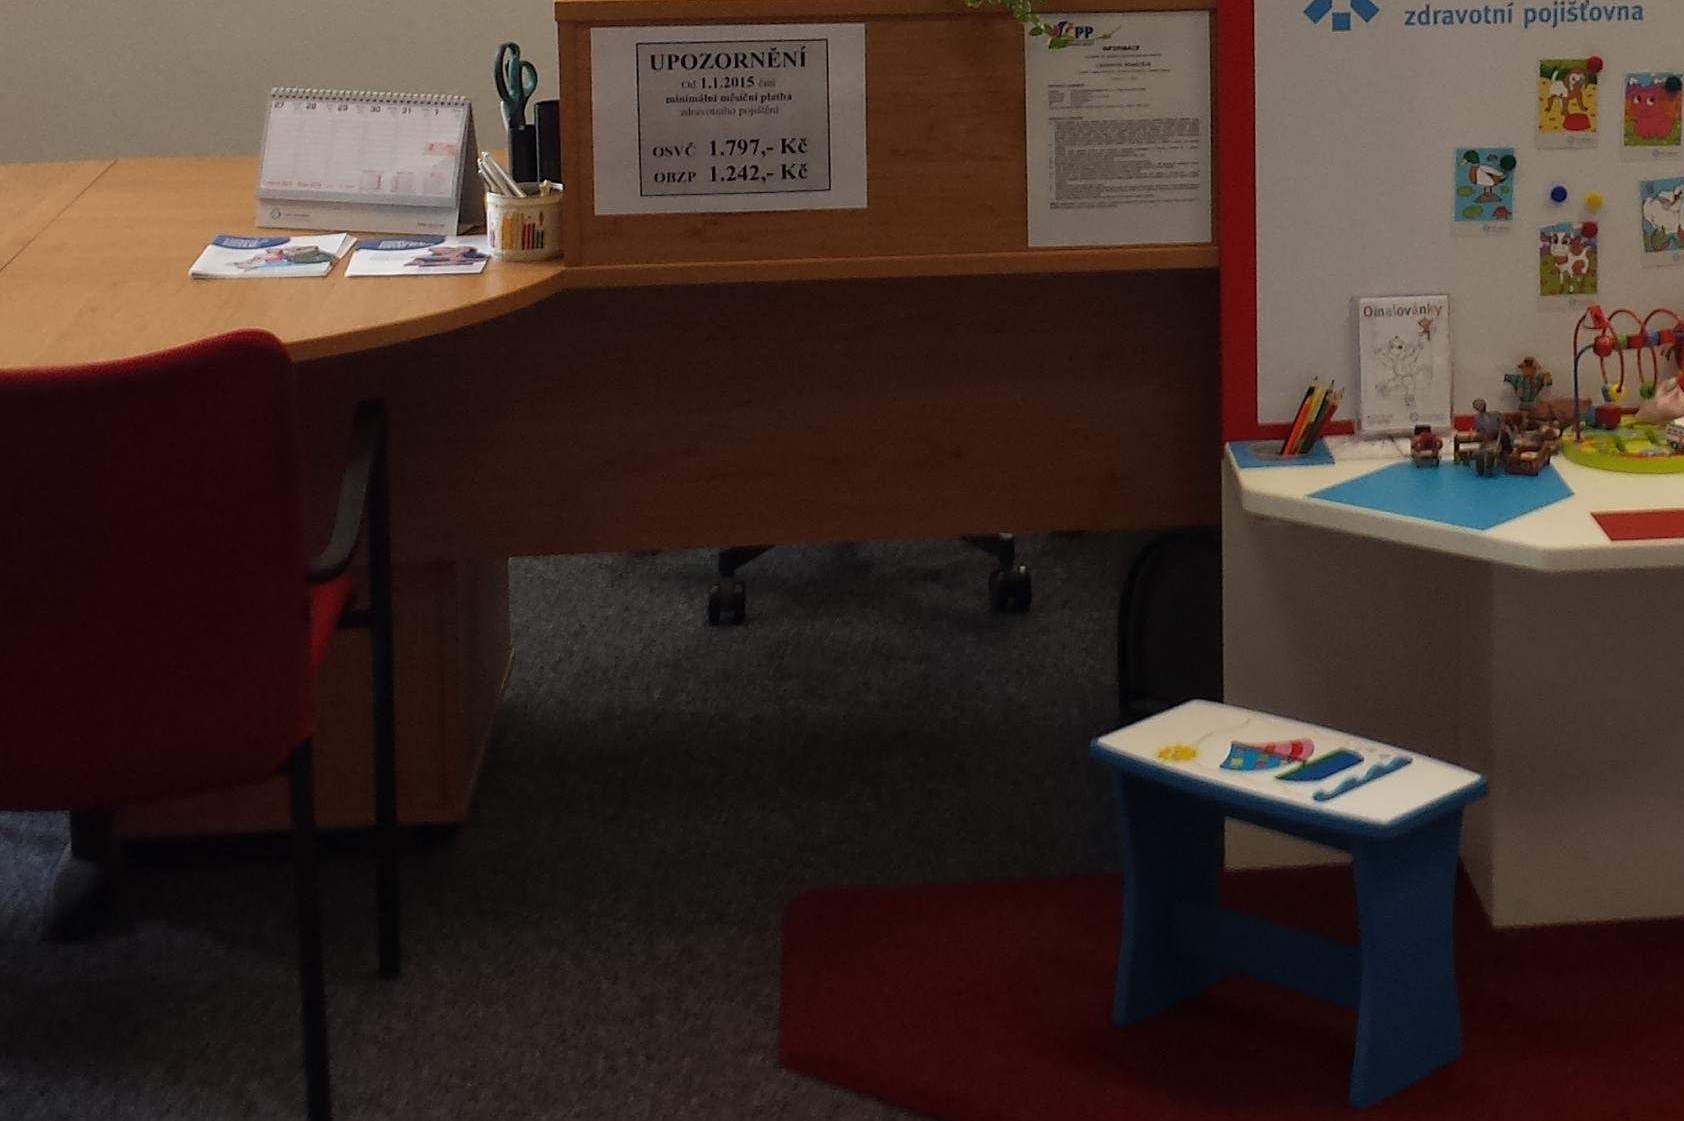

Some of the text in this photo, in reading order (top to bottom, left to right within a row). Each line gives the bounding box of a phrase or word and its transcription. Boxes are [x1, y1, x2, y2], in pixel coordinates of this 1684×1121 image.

[1404, 0, 1644, 28] zdravotní pojišťovna
[650, 45, 807, 71] UPOZORNĚNÍ
[681, 79, 697, 89] Od
[701, 76, 755, 89] 1.1.2015
[665, 92, 793, 104] minimální měsíční platba
[652, 137, 808, 158] OSVČ 1.797,- Kč
[654, 162, 808, 184] OBZP 1.242,- Kč
[1363, 302, 1442, 318] Omalovánky
